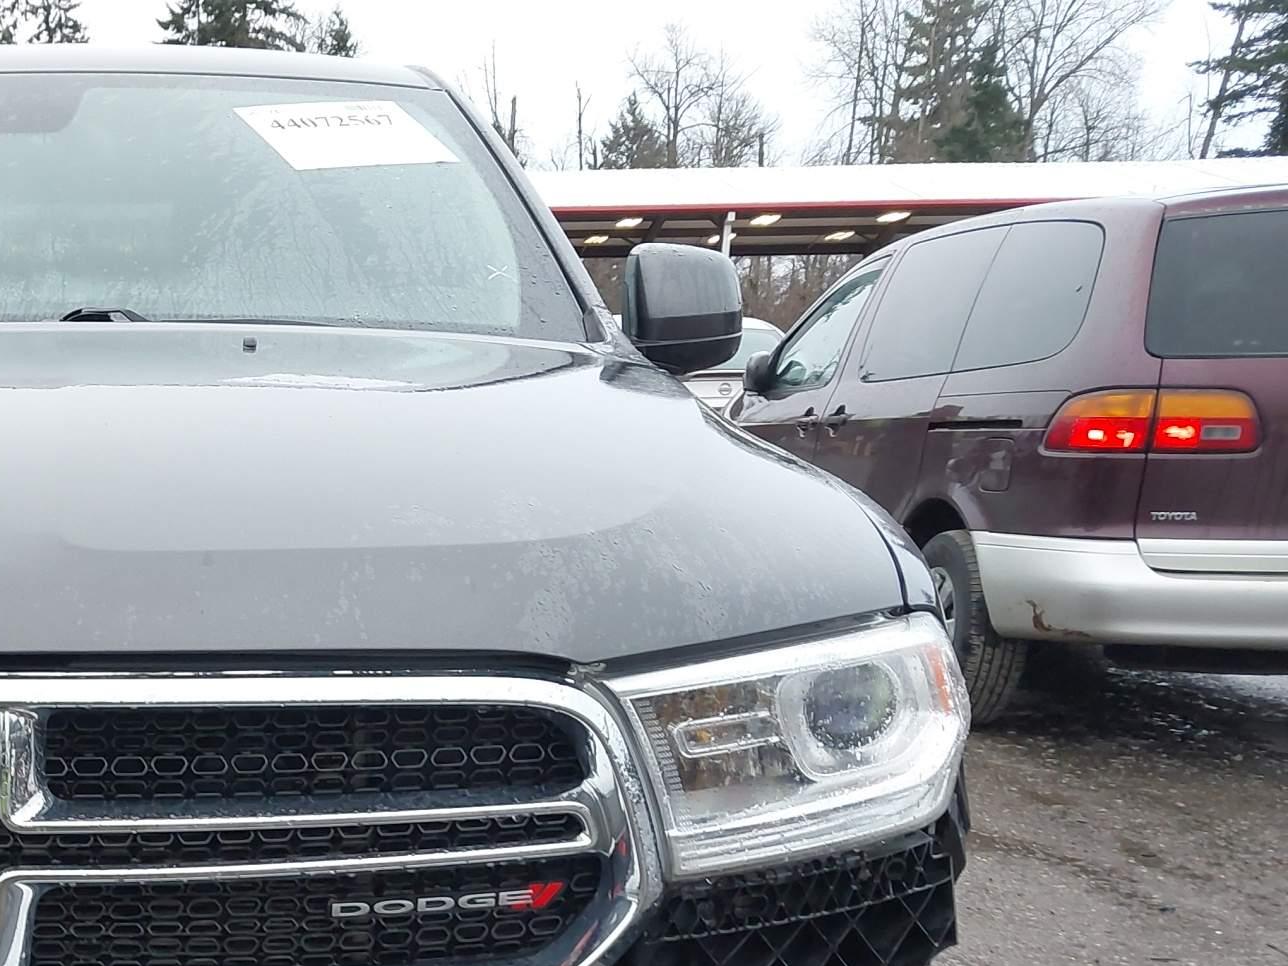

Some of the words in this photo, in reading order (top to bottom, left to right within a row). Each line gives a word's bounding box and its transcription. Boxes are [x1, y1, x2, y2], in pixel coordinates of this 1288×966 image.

[270, 114, 393, 130] 44072567
[1150, 511, 1198, 521] TOYOTA
[331, 889, 534, 918] DODGE
